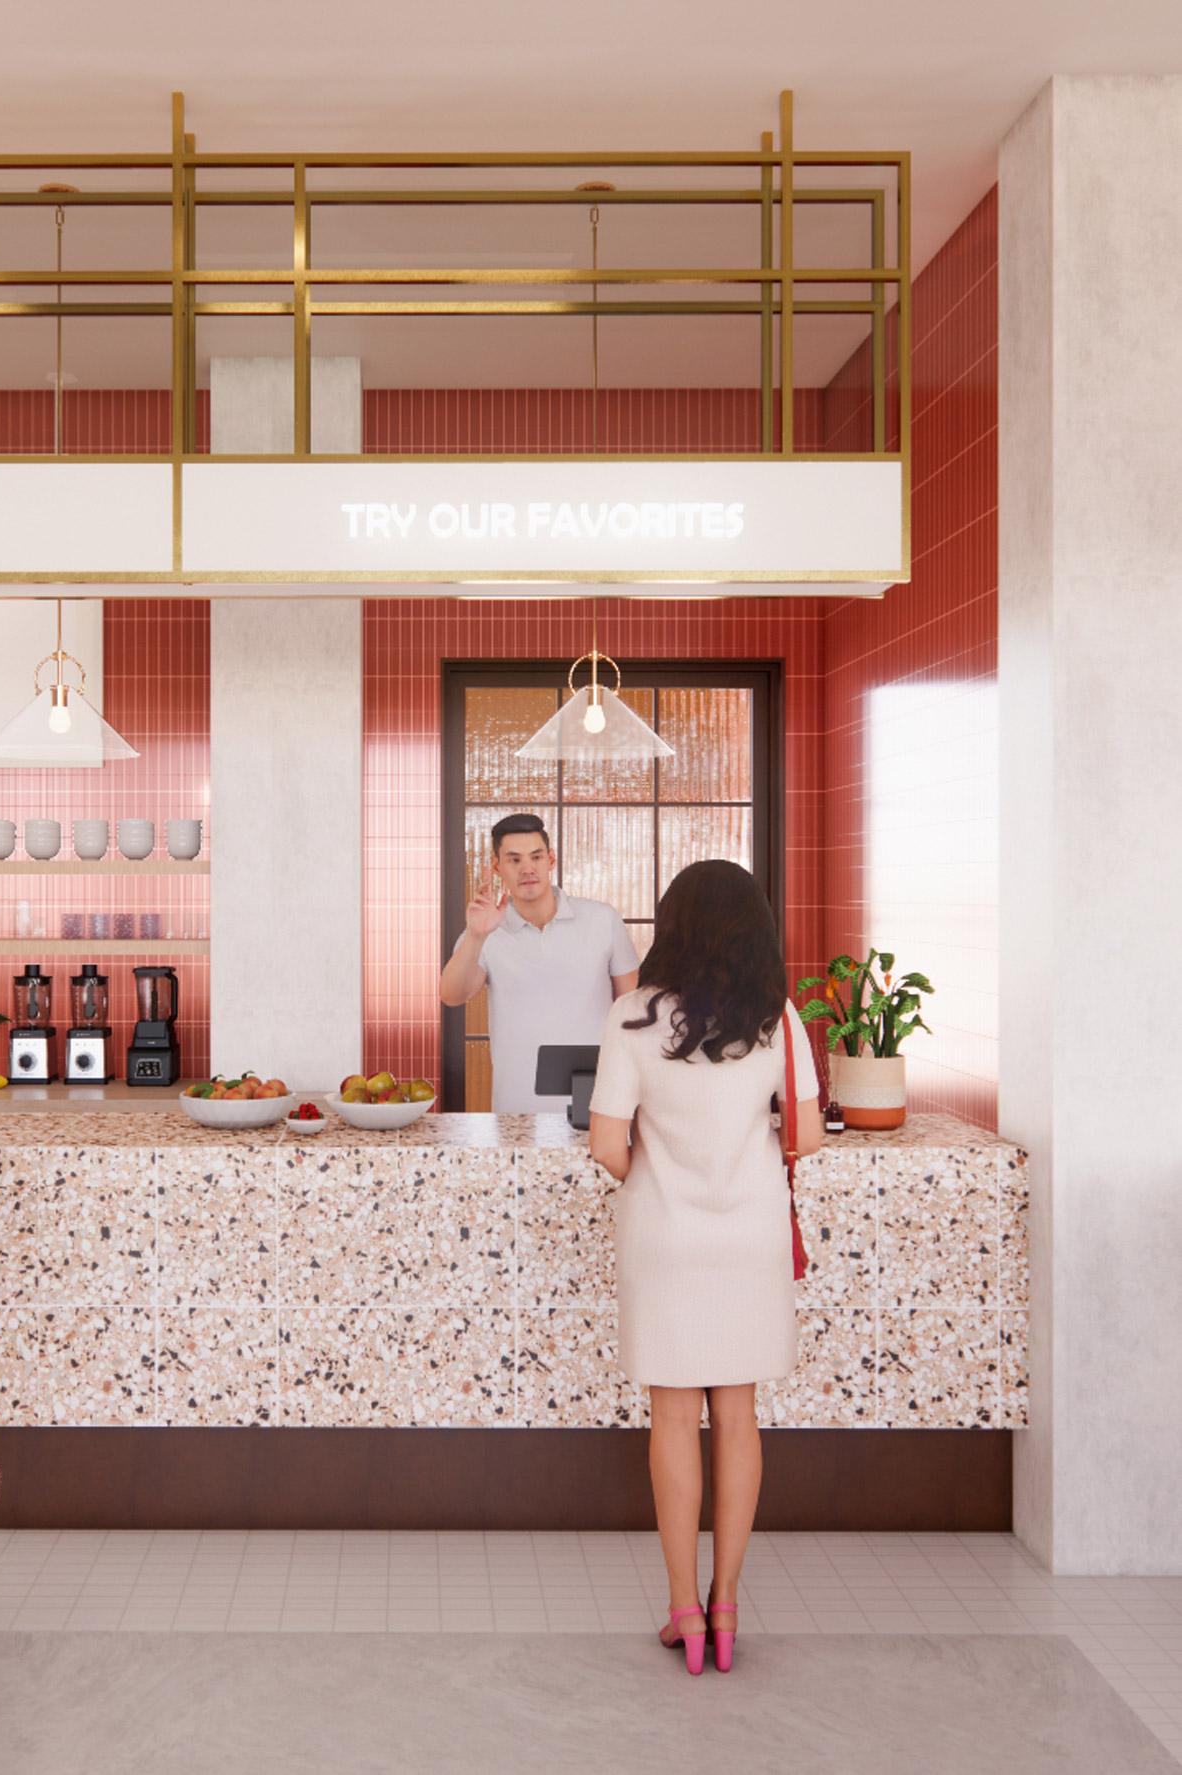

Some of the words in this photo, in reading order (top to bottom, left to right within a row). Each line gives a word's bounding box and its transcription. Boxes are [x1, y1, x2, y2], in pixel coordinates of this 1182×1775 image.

[342, 503, 416, 538] TRY
[429, 503, 515, 539] OUR
[528, 503, 745, 538] FAVORITES
